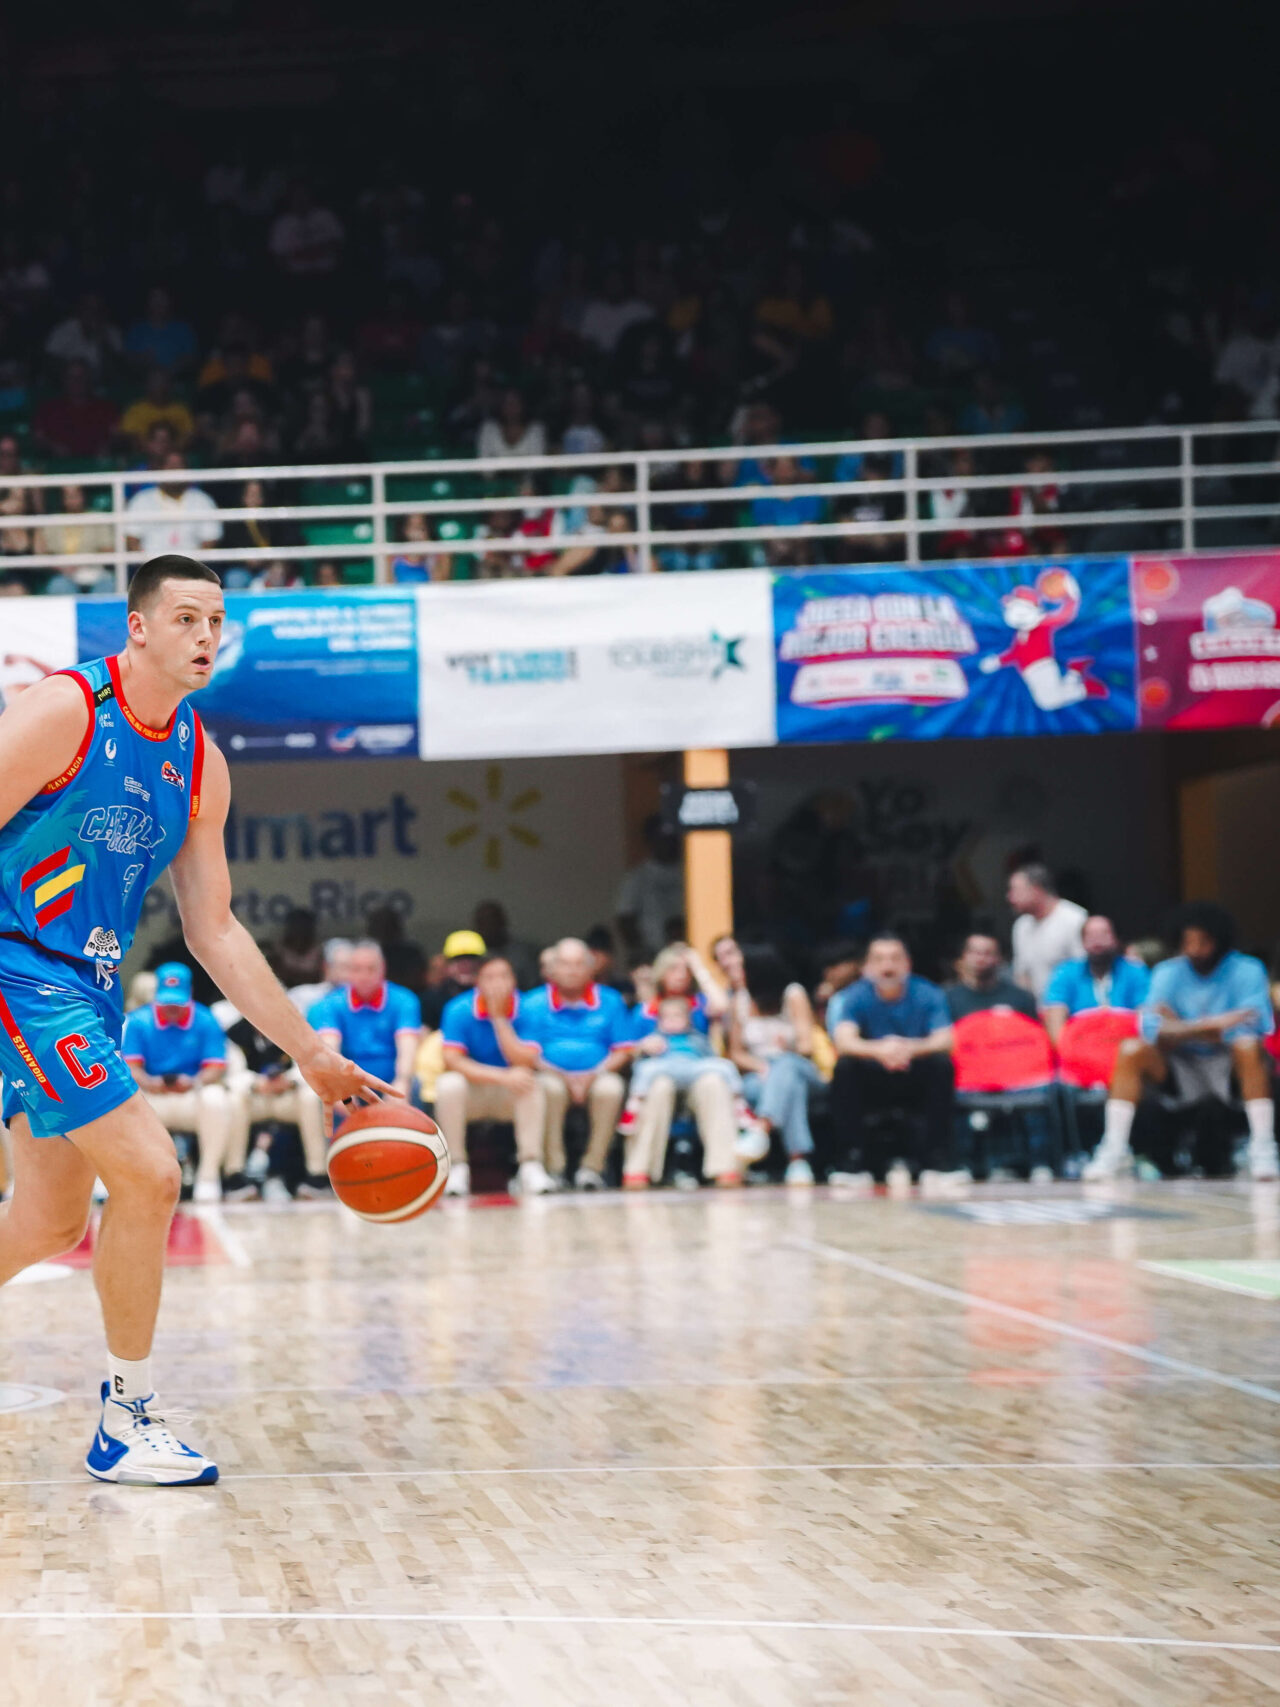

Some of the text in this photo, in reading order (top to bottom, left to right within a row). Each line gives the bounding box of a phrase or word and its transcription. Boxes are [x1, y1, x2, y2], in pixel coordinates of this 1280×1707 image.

[226, 793, 417, 862] lmart
[12, 1035, 47, 1084] GIGANTES
[55, 1032, 108, 1090] C
